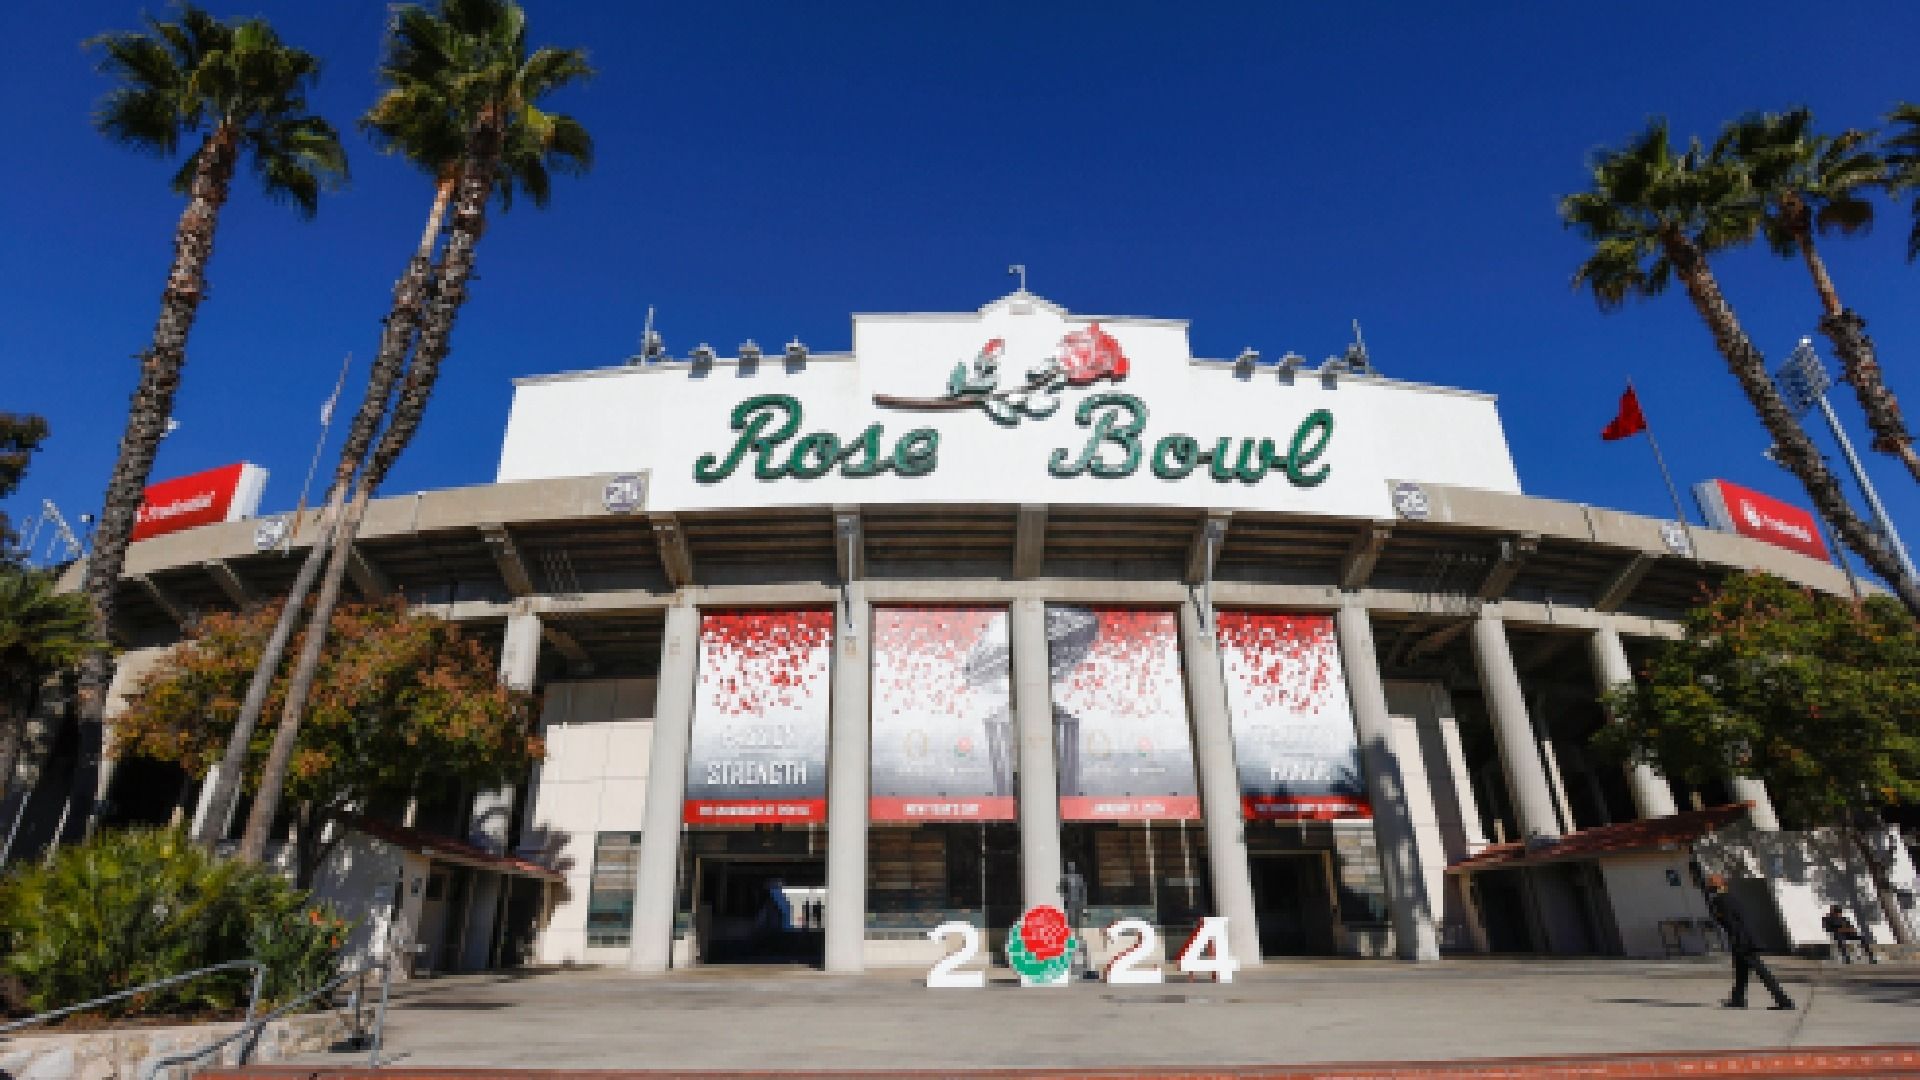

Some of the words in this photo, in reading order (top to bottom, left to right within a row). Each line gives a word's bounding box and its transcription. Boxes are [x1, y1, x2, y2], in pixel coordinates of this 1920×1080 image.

[693, 394, 941, 484] Rose
[1048, 391, 1334, 487] Bowl
[707, 760, 807, 785] STRENGTH
